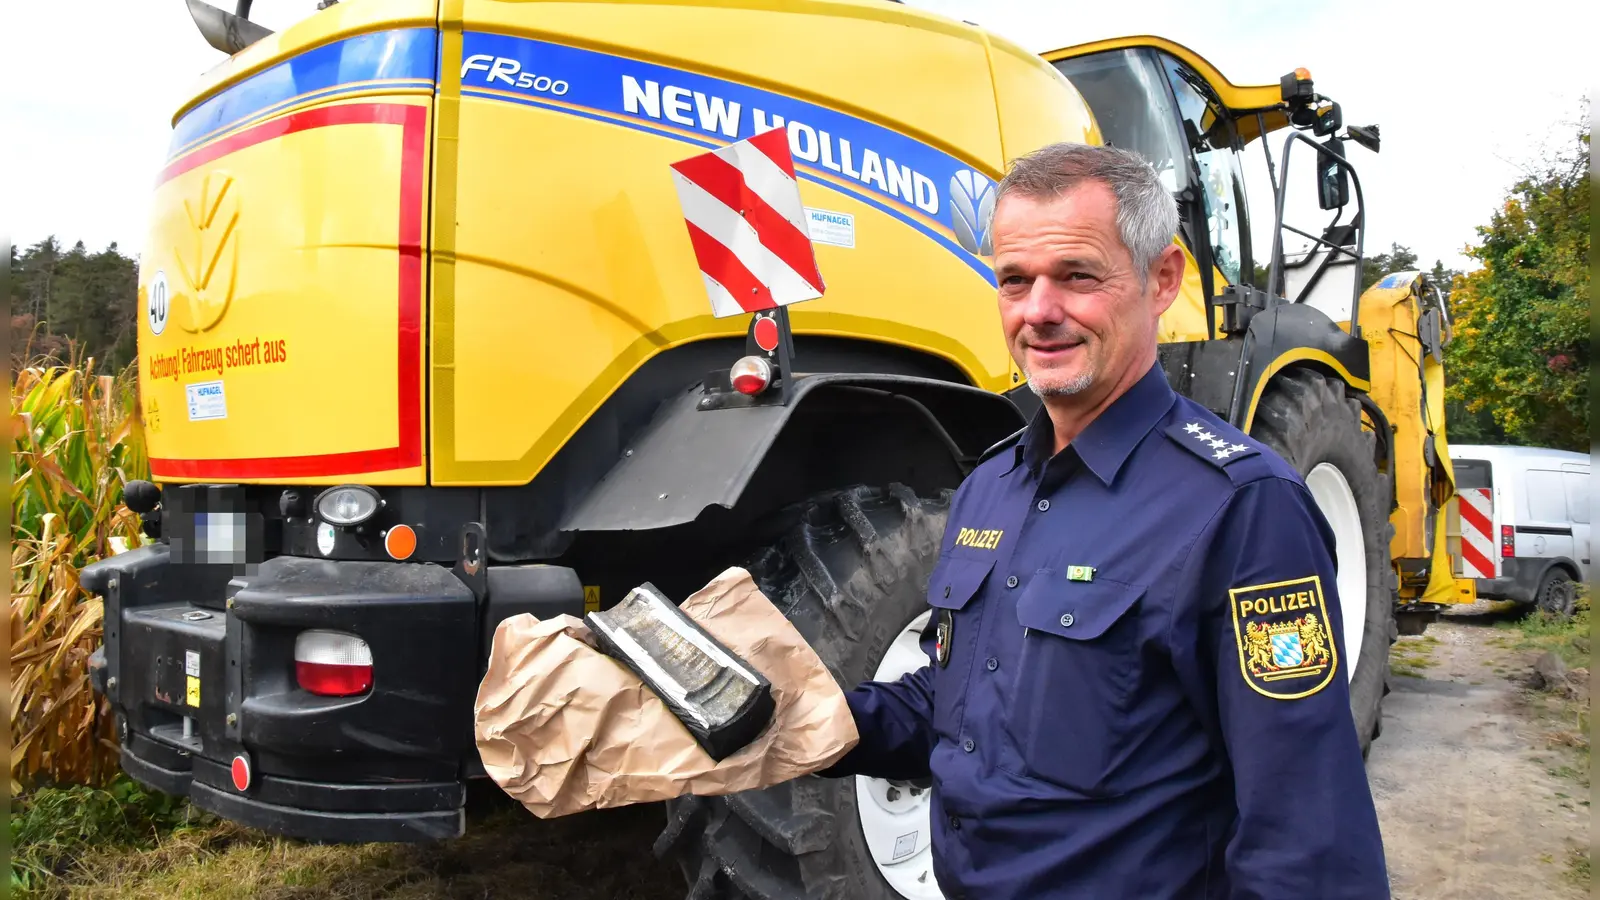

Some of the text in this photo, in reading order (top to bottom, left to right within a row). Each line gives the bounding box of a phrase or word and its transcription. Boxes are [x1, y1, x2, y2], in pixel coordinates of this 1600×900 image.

[622, 74, 939, 216] NEW HOLLAND
[811, 212, 851, 226] HUFNAGEL
[151, 280, 165, 324] 40
[149, 337, 286, 381] Achtung! Fahrzeug schert aus
[955, 527, 1004, 550] POLIZEI
[1240, 590, 1317, 618] POLIZEI
